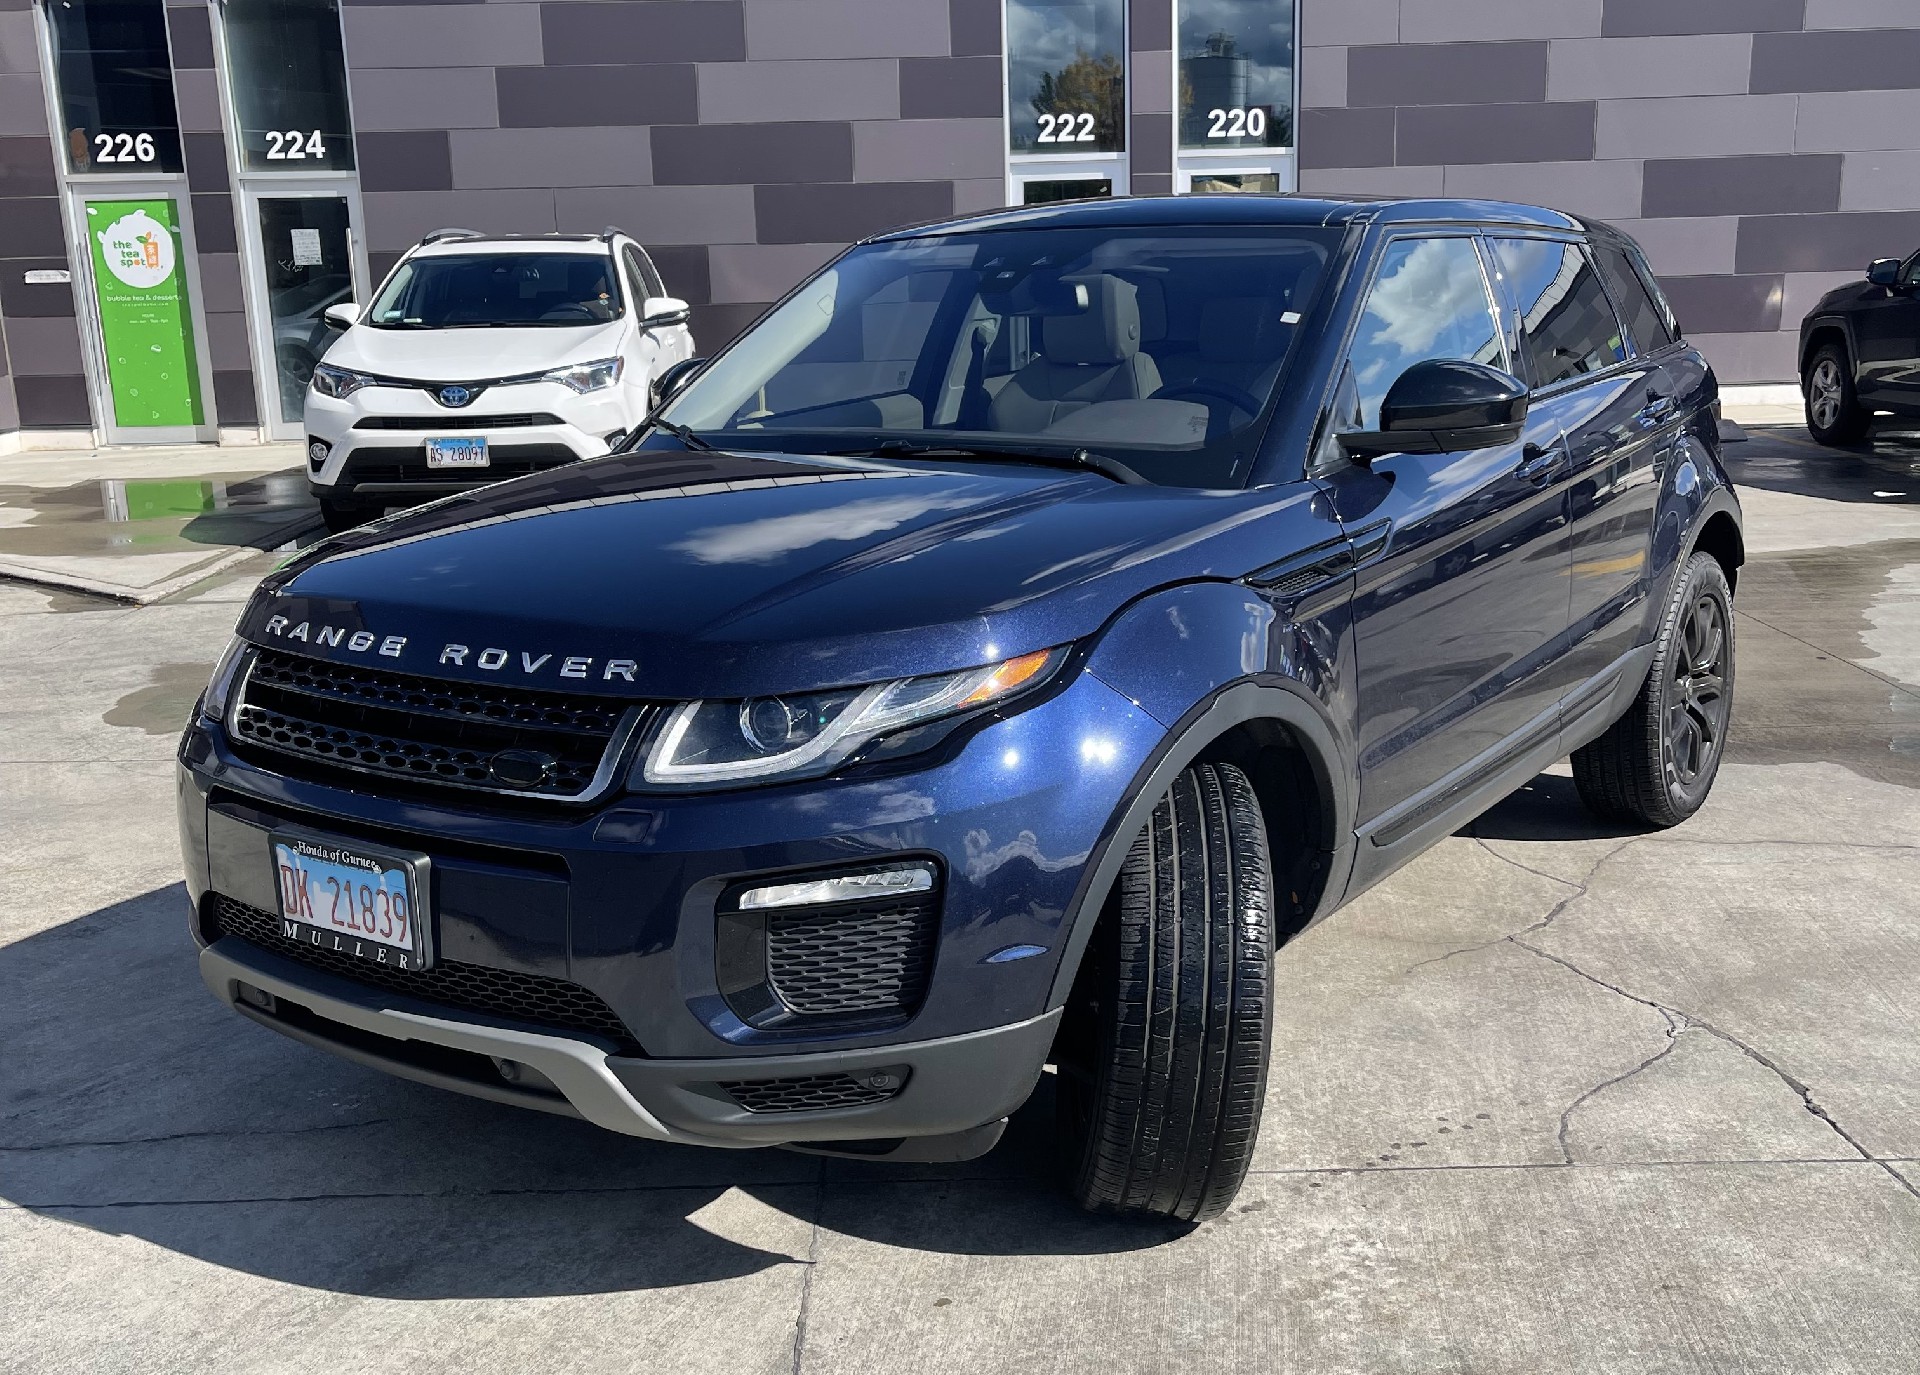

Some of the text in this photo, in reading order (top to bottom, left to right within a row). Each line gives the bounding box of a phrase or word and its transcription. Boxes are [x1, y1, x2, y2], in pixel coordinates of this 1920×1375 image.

[1037, 113, 1096, 143] 222
[1207, 108, 1266, 138] 220
[94, 132, 156, 163] 226
[265, 130, 326, 160] 224
[113, 240, 132, 249] the
[121, 250, 139, 258] tea
[120, 258, 146, 268] spot
[430, 446, 484, 462] AS 28097
[265, 614, 638, 682] RANGE ROVER
[297, 840, 328, 858] Honda
[330, 849, 340, 864] of
[281, 864, 406, 943] DK 21839
[283, 920, 408, 970] MULLER
